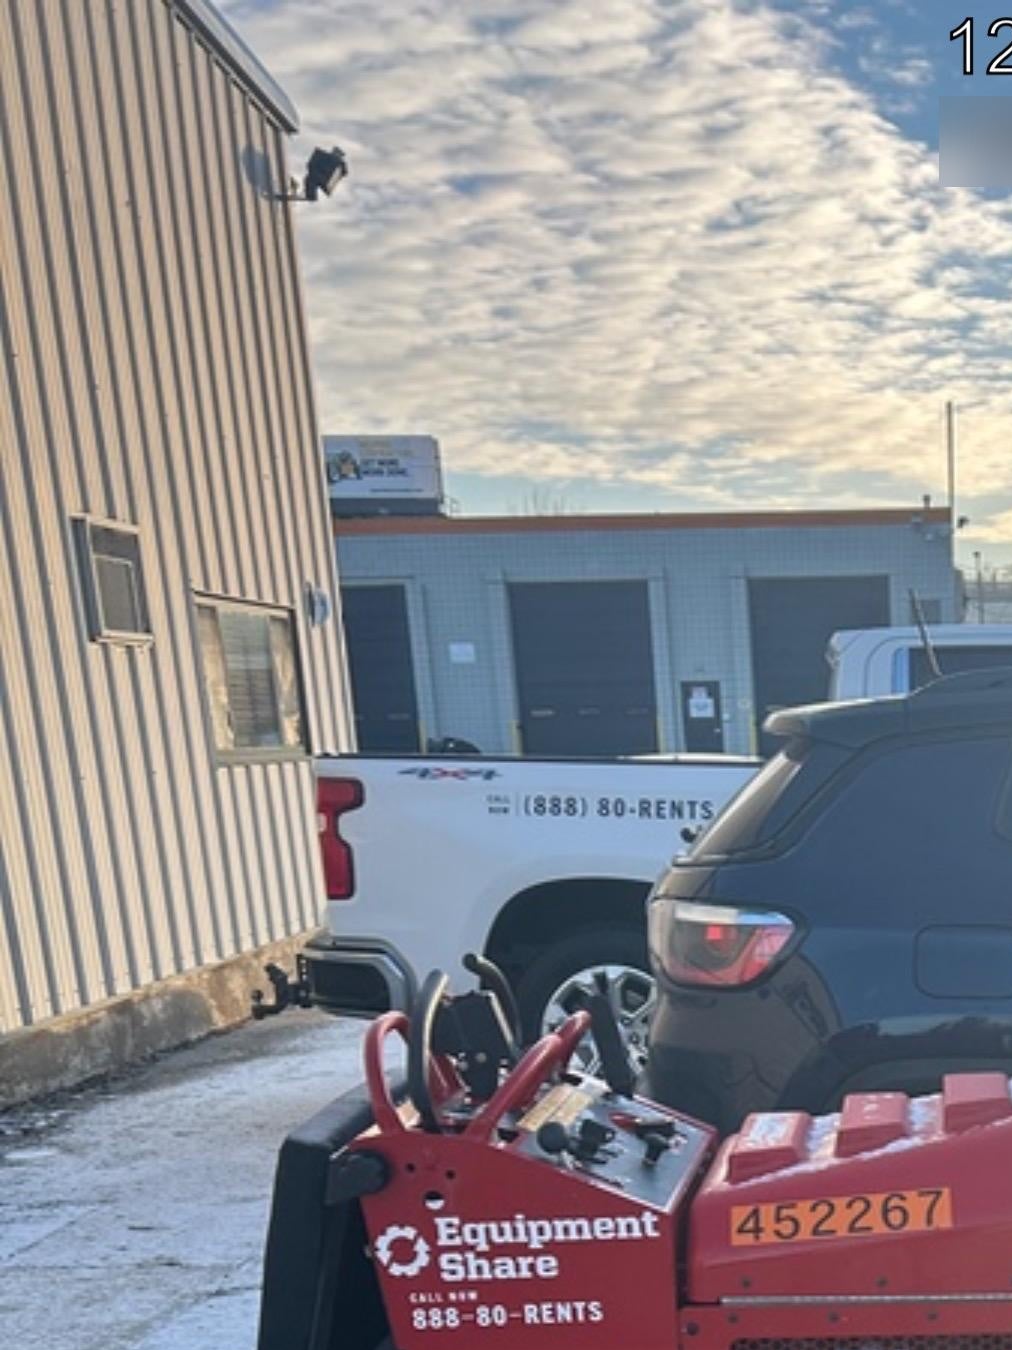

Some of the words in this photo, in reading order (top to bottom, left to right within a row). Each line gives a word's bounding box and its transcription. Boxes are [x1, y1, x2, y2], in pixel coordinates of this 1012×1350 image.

[523, 796, 587, 817] (888)
[596, 798, 714, 820] 80-RENTS
[736, 1190, 942, 1240] 452267
[434, 1211, 660, 1251] Equipment
[439, 1252, 559, 1281] Share
[412, 1301, 603, 1330] 888-80-RENTS
